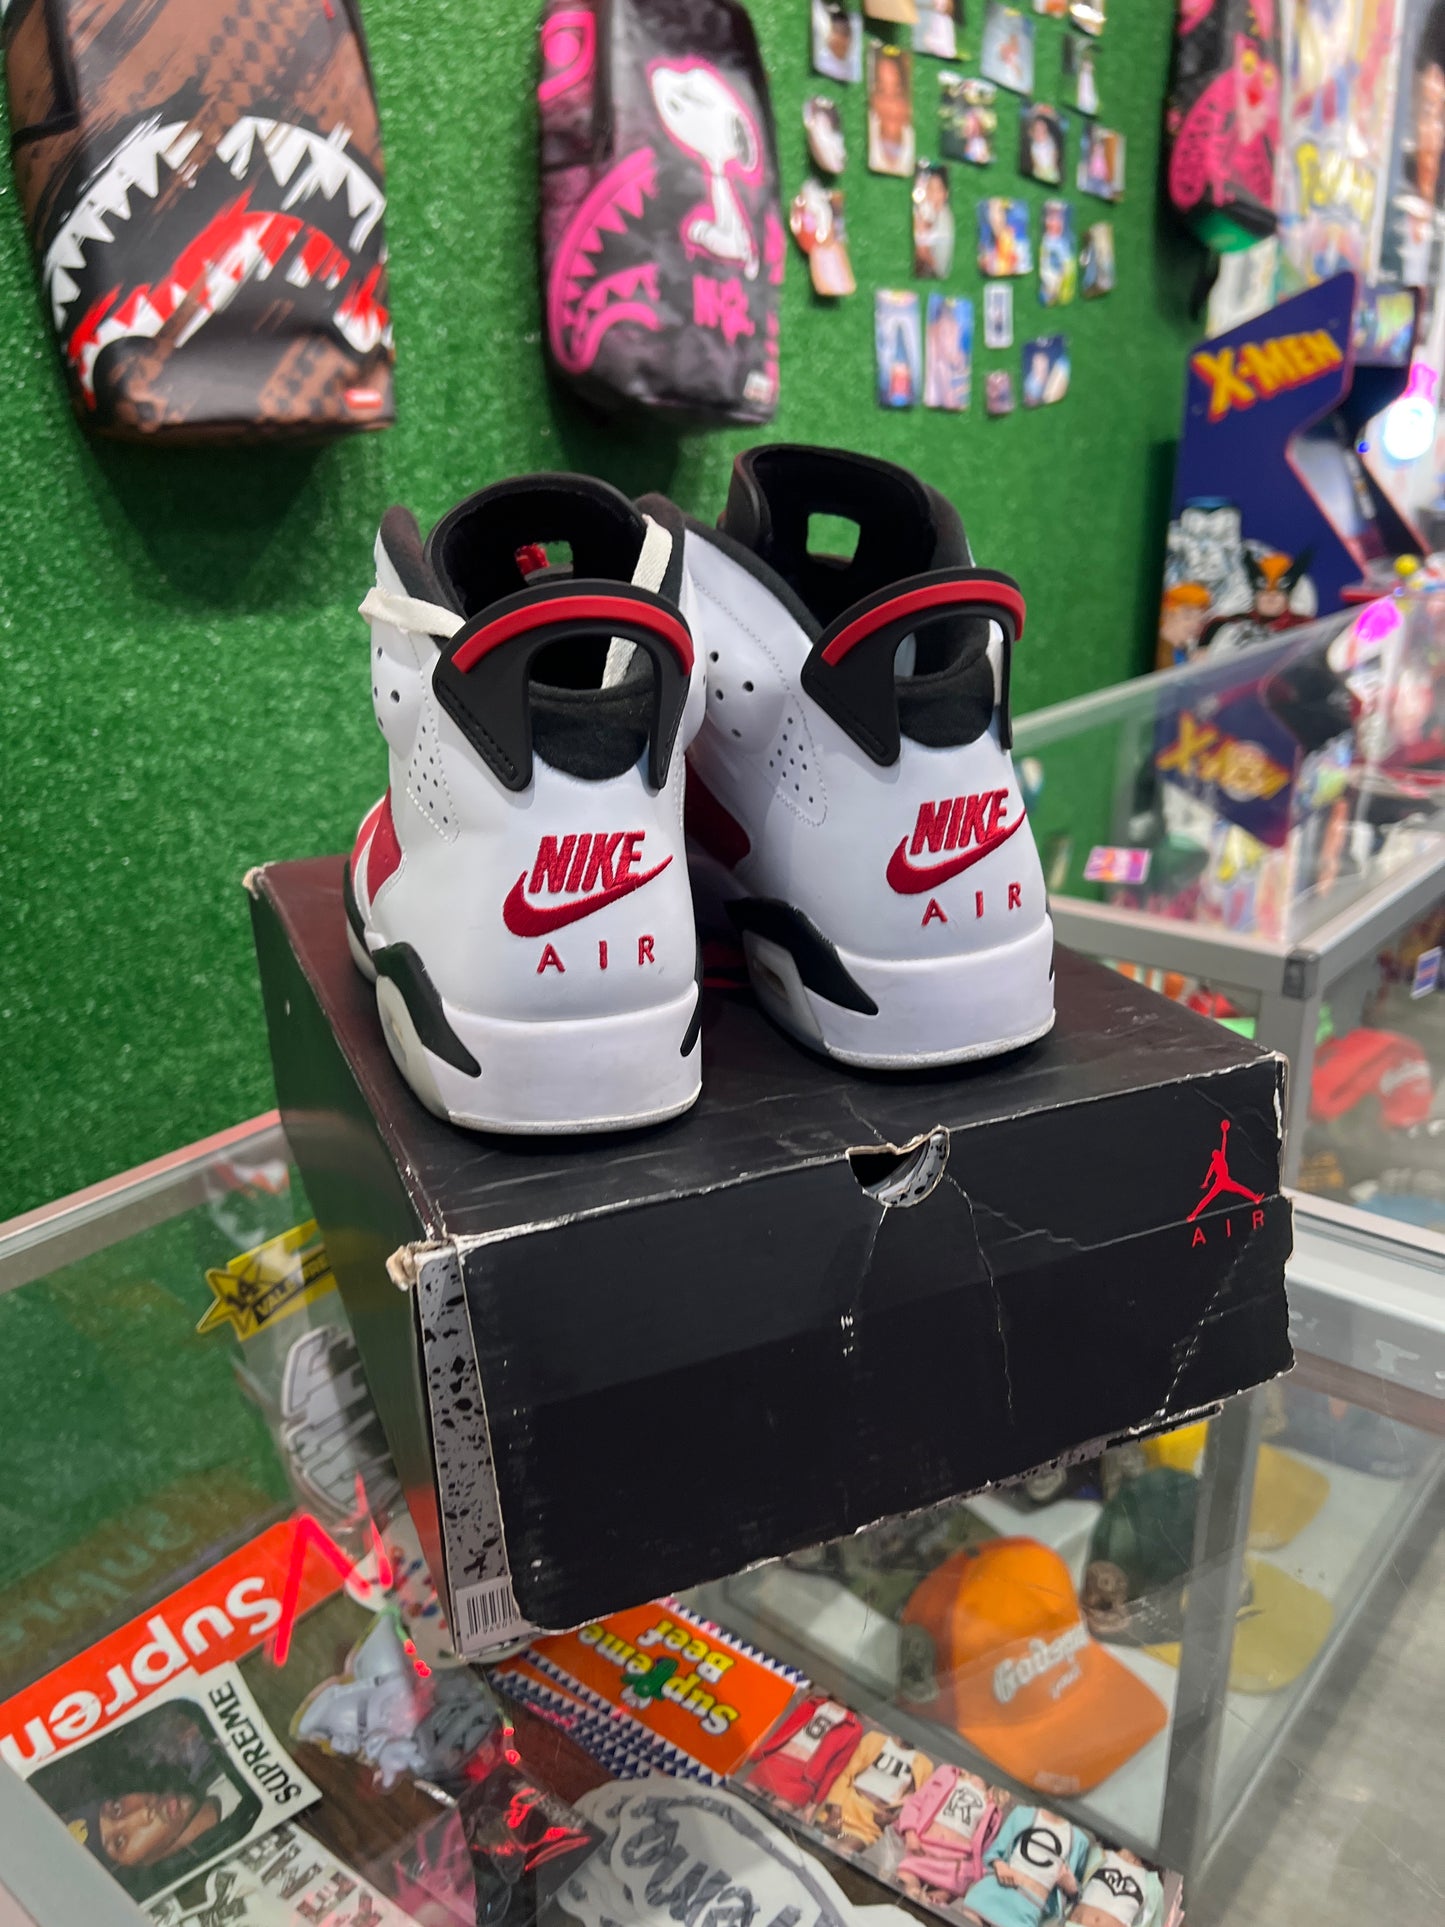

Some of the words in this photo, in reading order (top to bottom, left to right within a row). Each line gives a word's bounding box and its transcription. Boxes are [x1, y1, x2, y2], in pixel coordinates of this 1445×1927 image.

[1190, 328, 1345, 422] X-MEN
[909, 787, 1010, 856] NIKE
[527, 830, 646, 895] NIKE
[920, 881, 1023, 928] AIR
[536, 934, 656, 975] AIR
[1190, 1208, 1265, 1249] AIR
[577, 1622, 740, 1736] Supeme
[636, 1619, 735, 1684] Beef
[207, 1680, 302, 1805] SUPREME
[874, 1751, 912, 1778] UP
[1020, 1827, 1063, 1868] e
